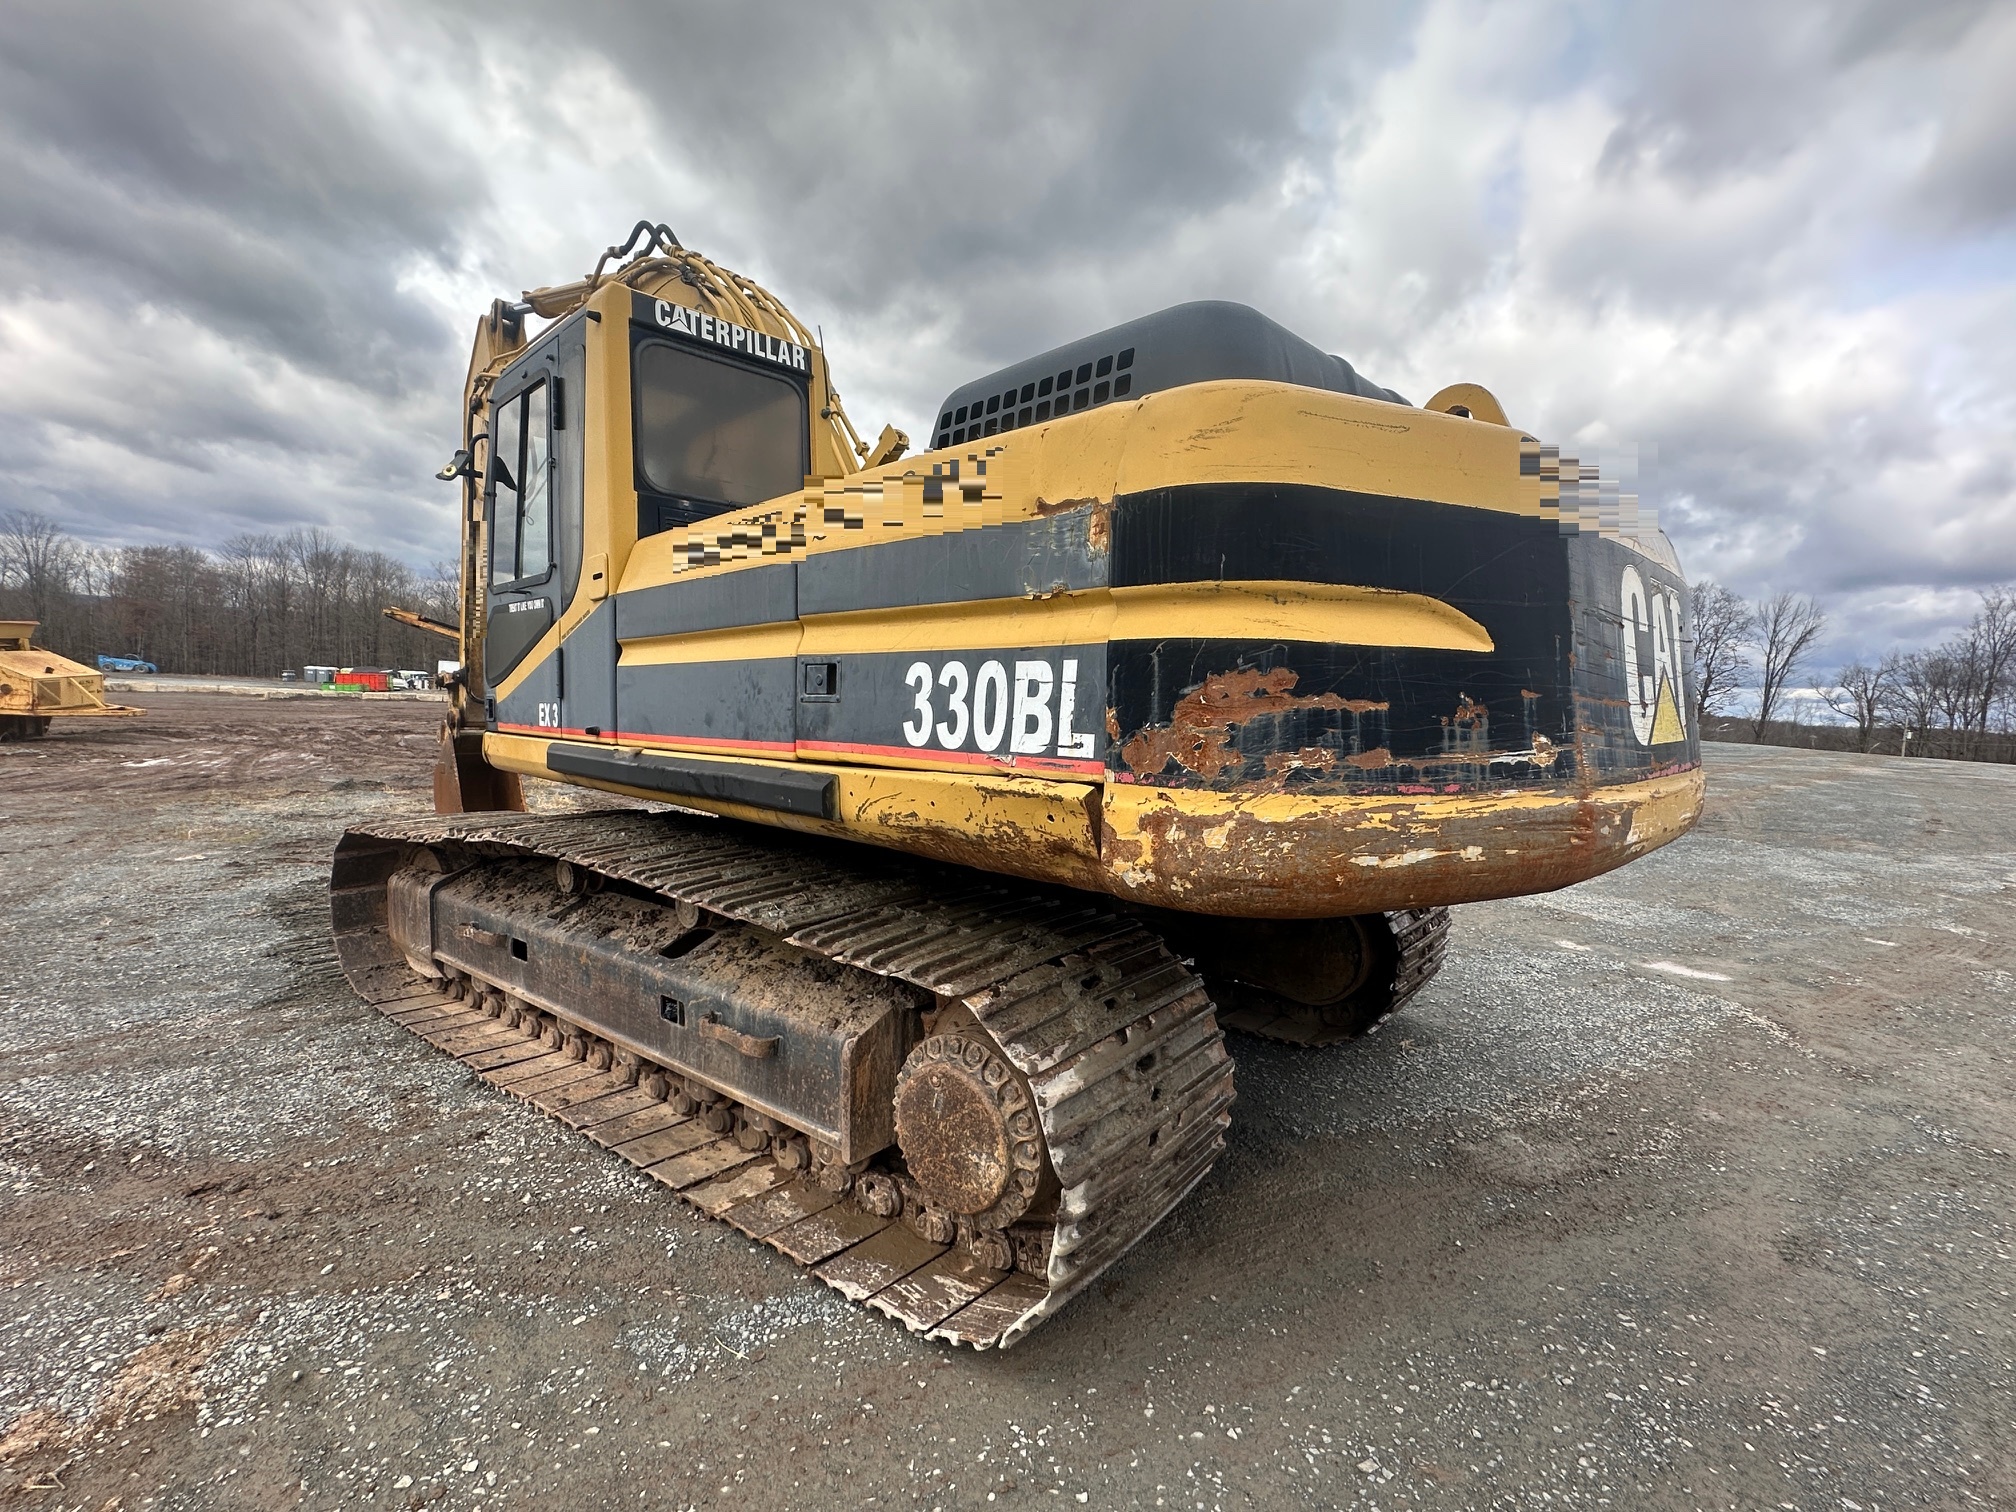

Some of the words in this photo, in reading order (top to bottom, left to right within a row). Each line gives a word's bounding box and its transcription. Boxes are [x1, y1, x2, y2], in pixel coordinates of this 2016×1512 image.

[654, 299, 806, 371] CATERPILLAR
[1621, 564, 1687, 746] CAT
[538, 702, 551, 727] EX
[552, 702, 559, 728] 3
[902, 658, 1095, 759] 330BL
